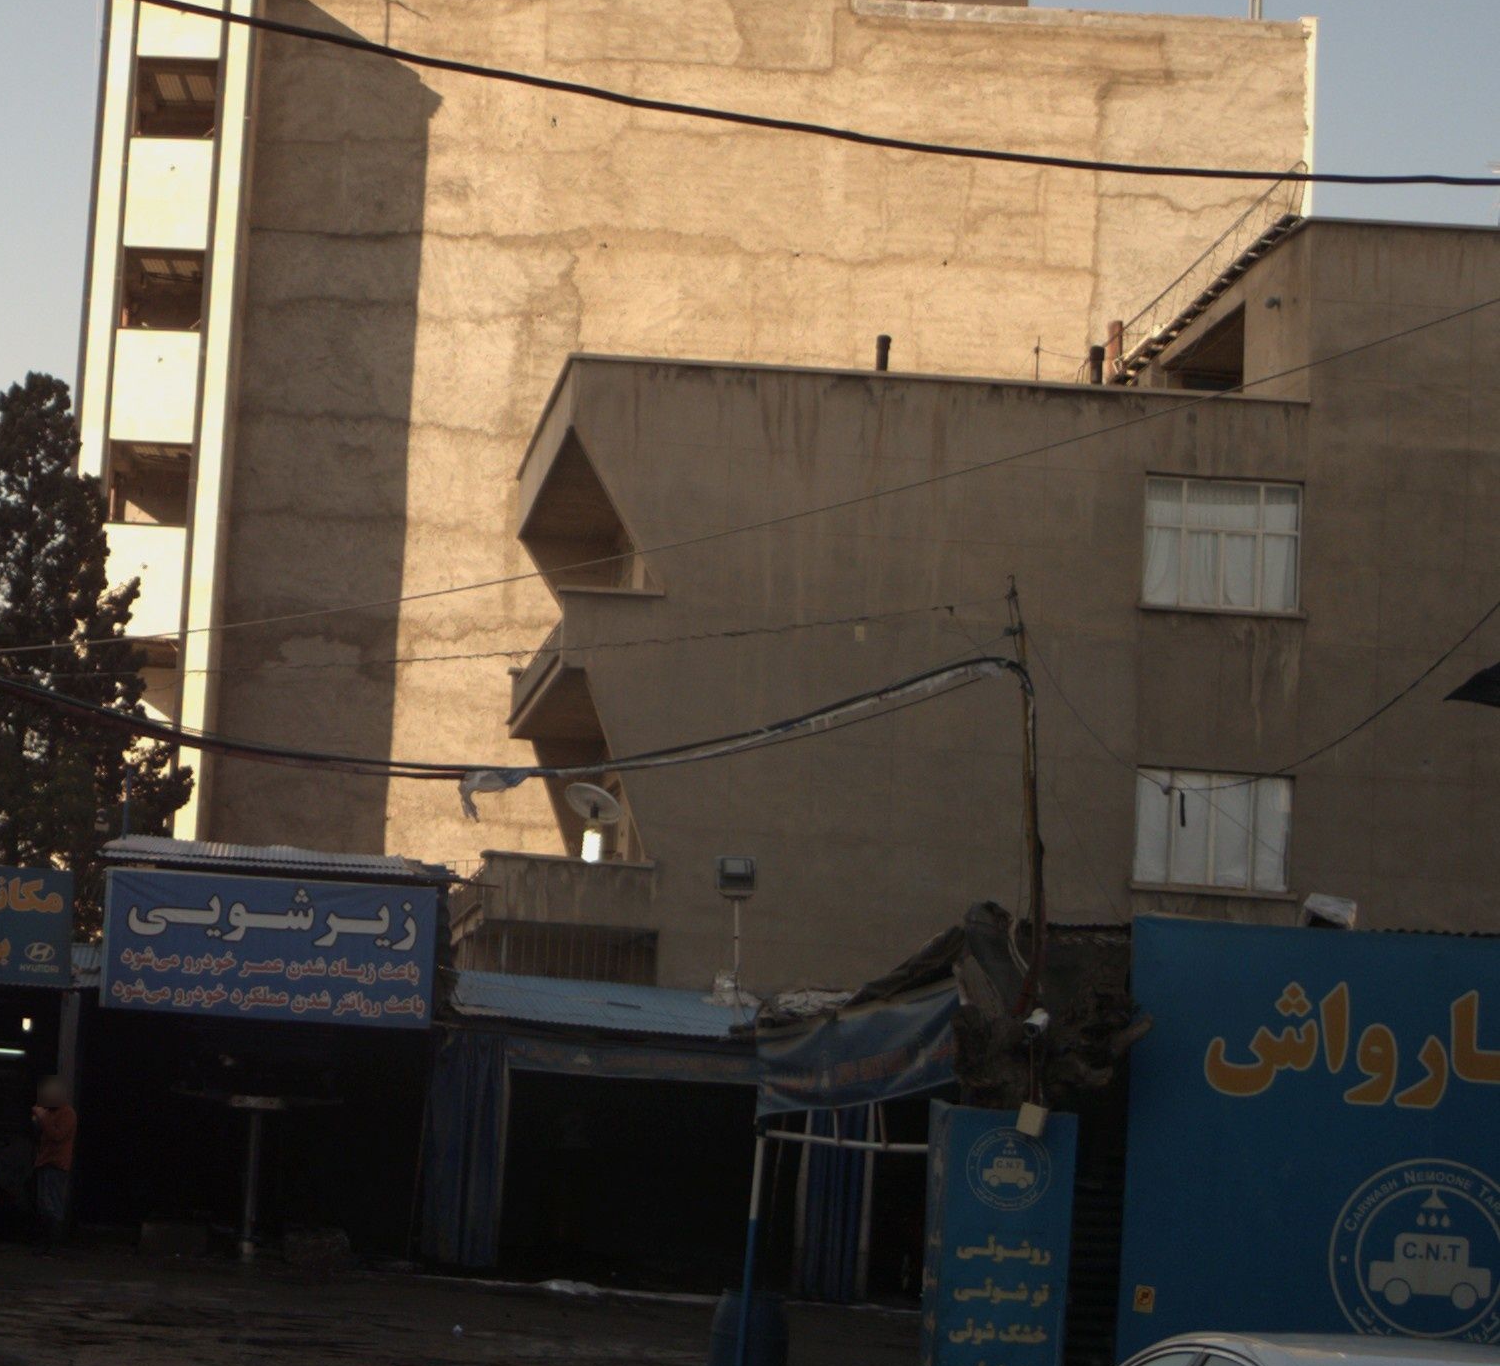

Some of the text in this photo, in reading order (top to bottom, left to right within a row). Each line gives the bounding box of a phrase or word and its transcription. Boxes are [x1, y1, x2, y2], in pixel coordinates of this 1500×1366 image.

[183, 950, 236, 974] خودرو
[239, 958, 284, 977] عمر
[286, 956, 326, 980] شدن
[328, 958, 376, 984] زیاد
[378, 960, 419, 985] باعث
[174, 984, 228, 1006] خودرو
[230, 986, 288, 1010] عملکرد
[290, 990, 331, 1012] شدن
[384, 994, 425, 1019] باعث
[1204, 981, 1500, 1109] ارواش
[1403, 1242, 1461, 1262] C.N.T
